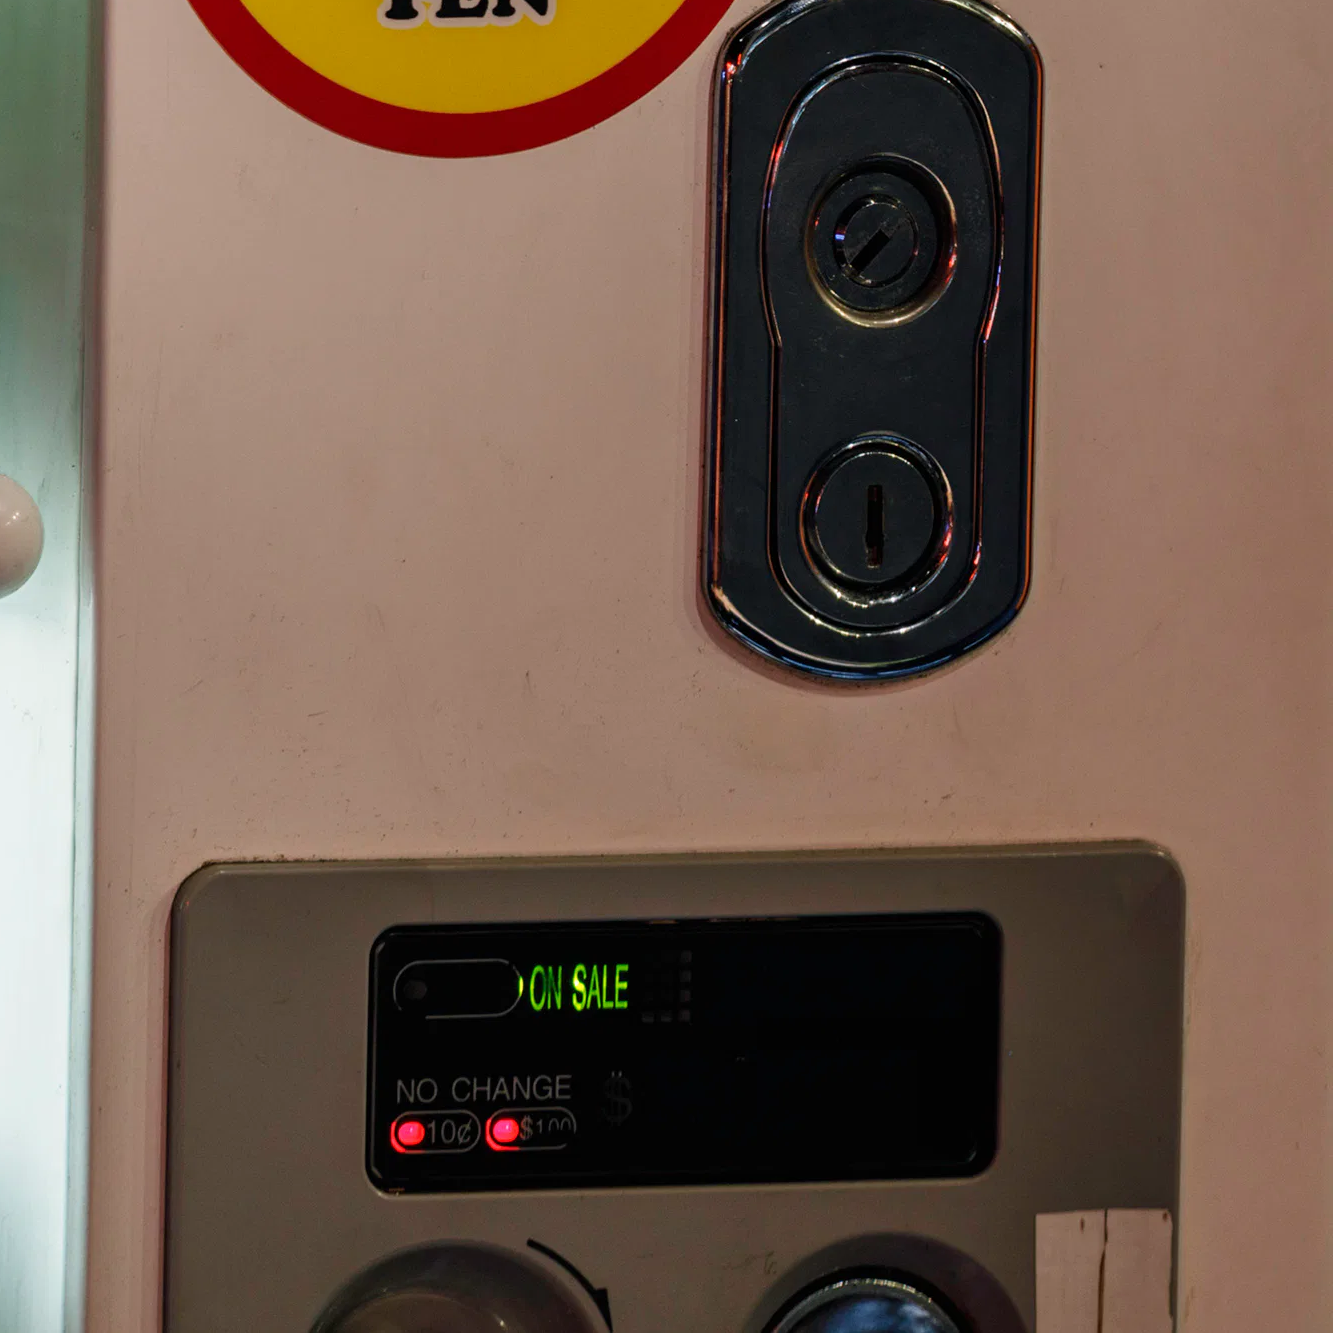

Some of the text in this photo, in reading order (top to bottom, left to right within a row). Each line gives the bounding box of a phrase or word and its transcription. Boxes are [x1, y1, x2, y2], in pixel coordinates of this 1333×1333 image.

[529, 963, 630, 1012] ON SALE
[395, 1074, 573, 1104] NO CHANGE
